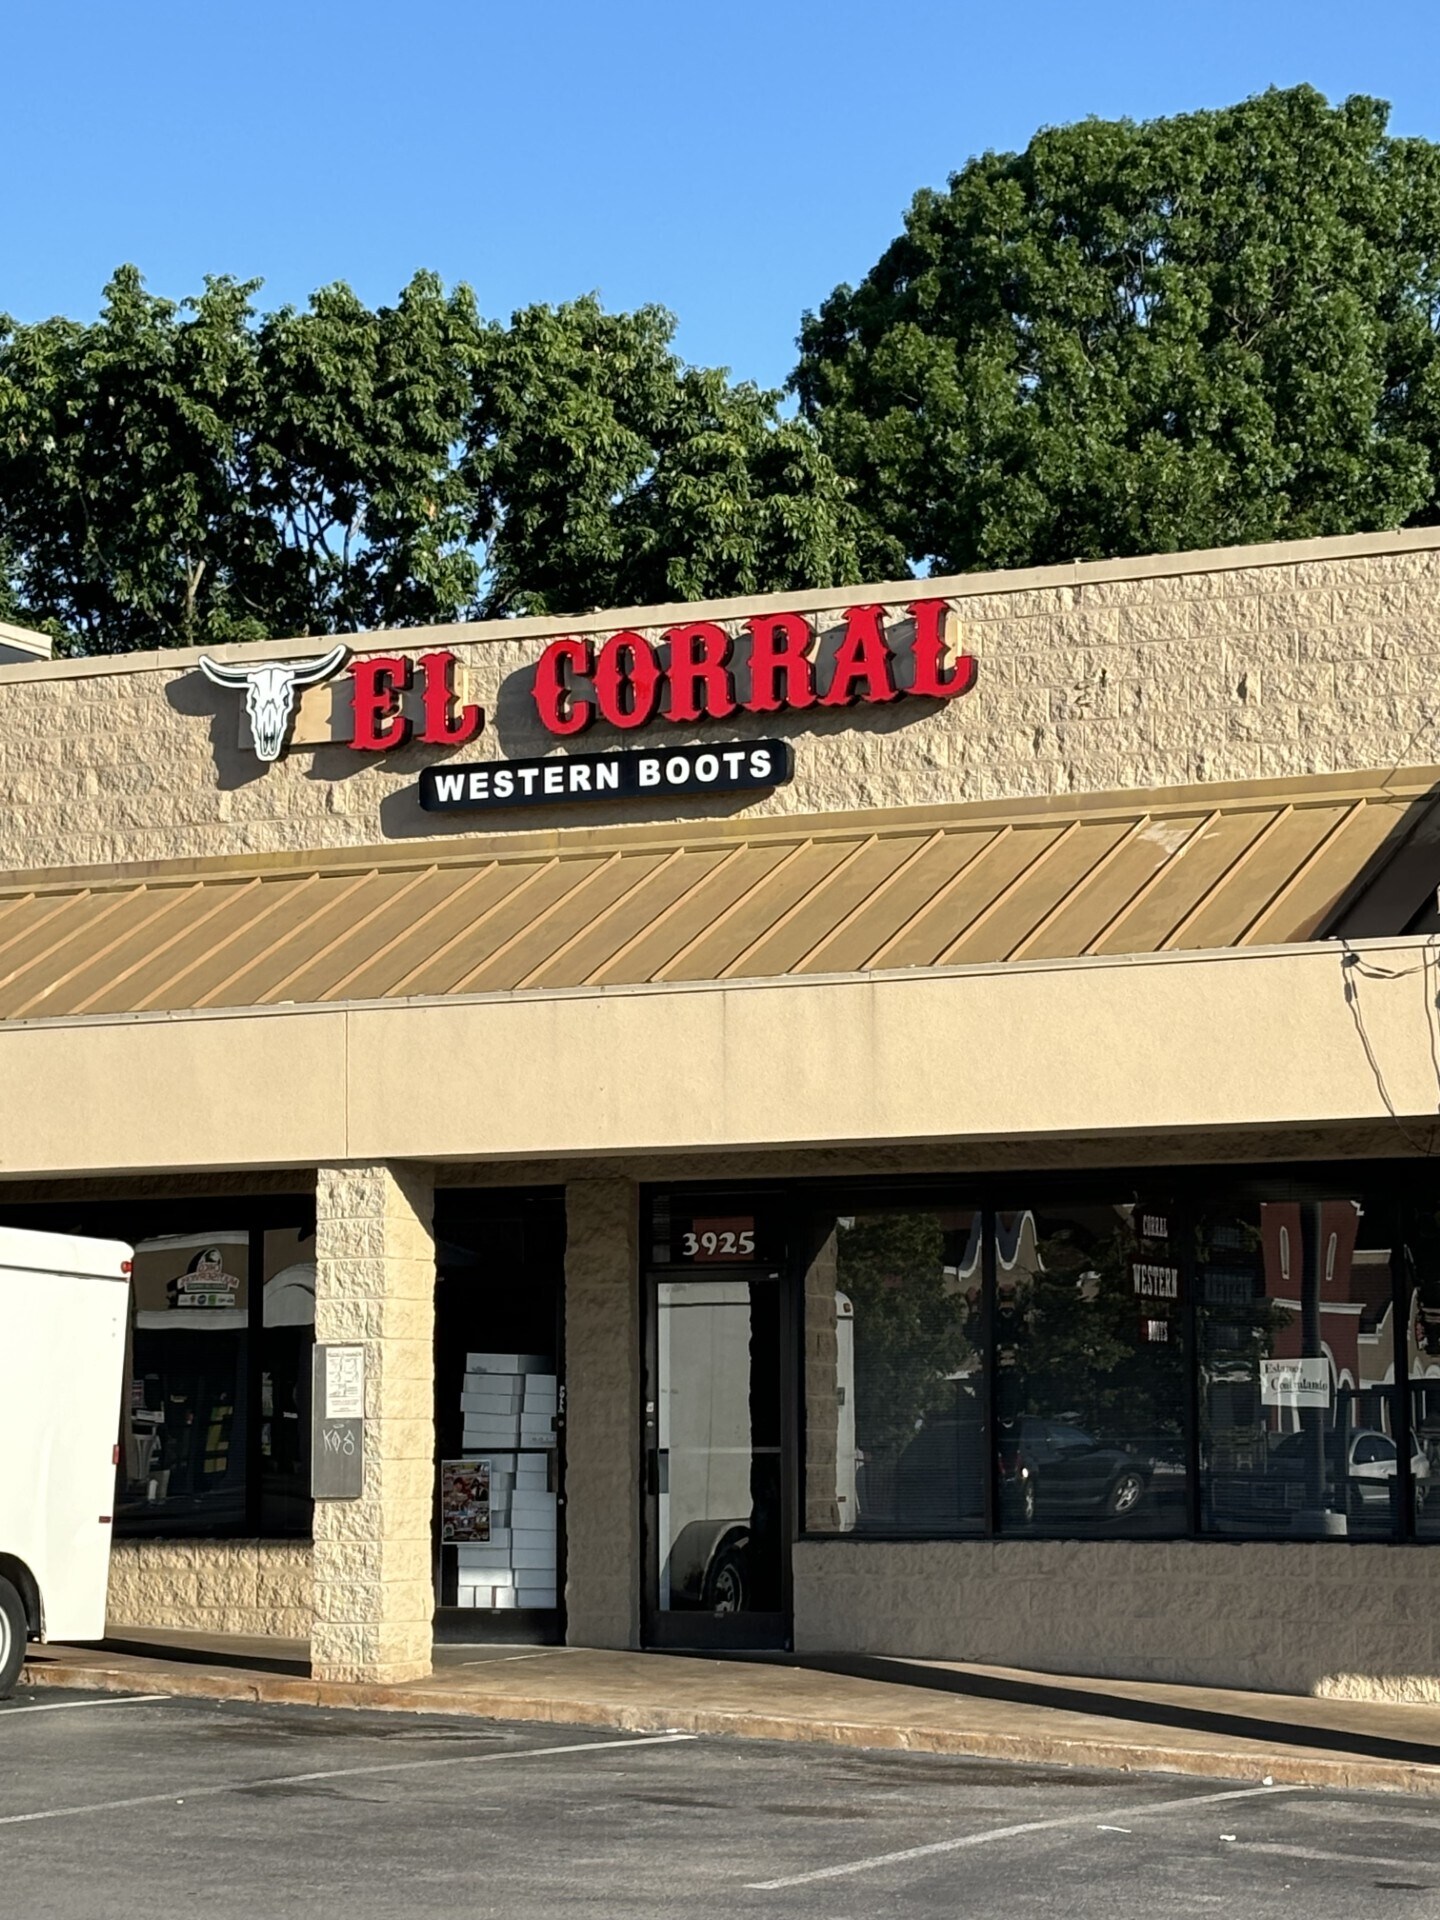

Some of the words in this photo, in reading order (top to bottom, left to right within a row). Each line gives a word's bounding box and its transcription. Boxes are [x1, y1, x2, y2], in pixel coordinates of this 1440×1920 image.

[346, 651, 481, 749] EL
[531, 599, 976, 735] CORRAL
[435, 762, 619, 802] WESTERN
[638, 750, 772, 787] BOOTS
[682, 1231, 755, 1256] 3925
[1132, 1263, 1178, 1298] WESTERN
